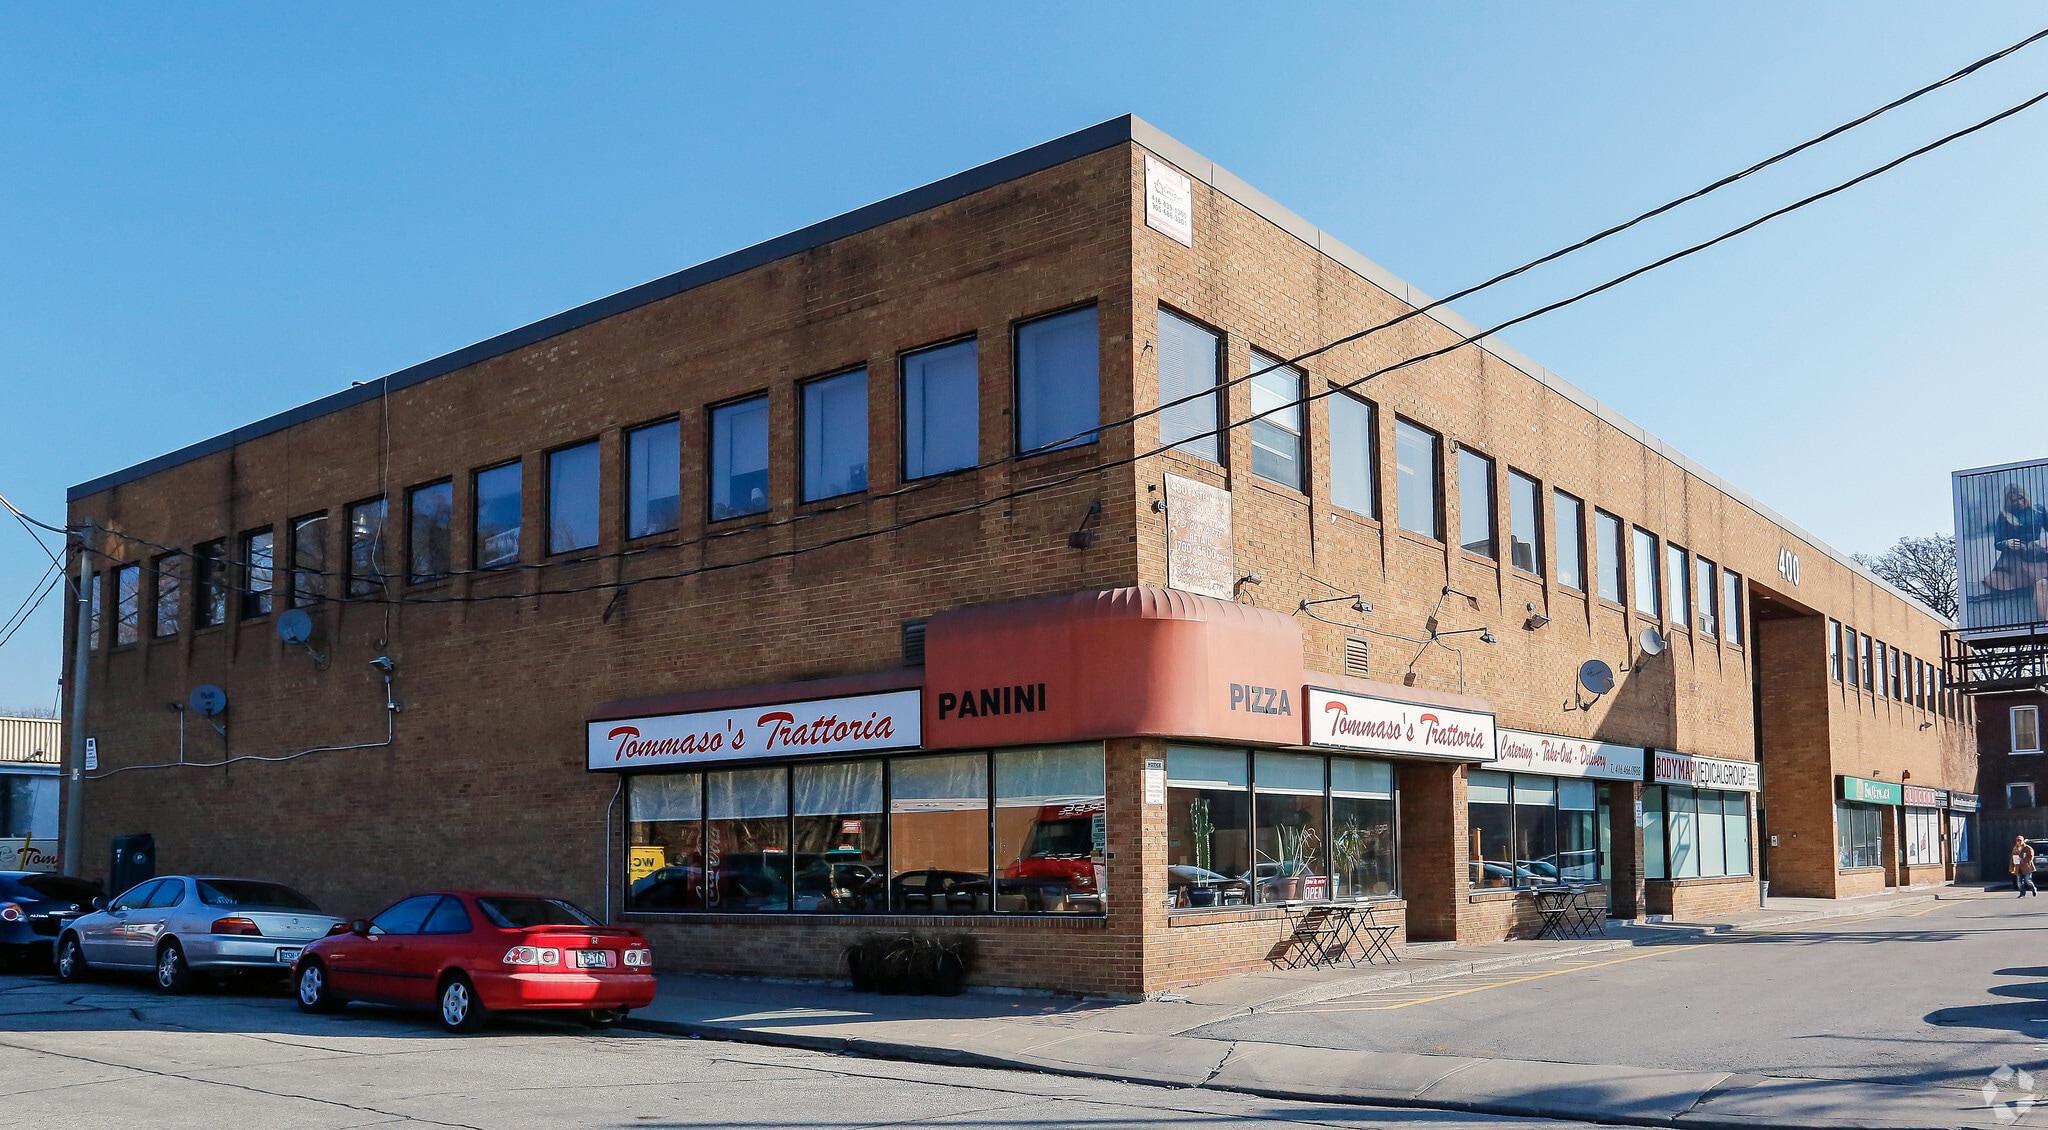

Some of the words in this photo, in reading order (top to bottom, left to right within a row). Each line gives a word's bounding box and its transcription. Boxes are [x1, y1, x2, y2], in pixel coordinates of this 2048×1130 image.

[1171, 482, 1187, 495] 400
[1190, 533, 1212, 546] RETAIL
[1778, 546, 1800, 586] 400
[939, 683, 1046, 720] PANINI
[1230, 683, 1292, 717] PIZZA
[608, 718, 746, 762] Tommaso's
[757, 710, 896, 750] Trattoria
[1325, 700, 1415, 741] Tommaso's
[1420, 713, 1485, 749] Trattoria
[1500, 734, 1533, 767] Catering
[1541, 740, 1573, 764] Take-Out
[1580, 744, 1608, 772] Delivery
[1305, 886, 1324, 900] OPEN
